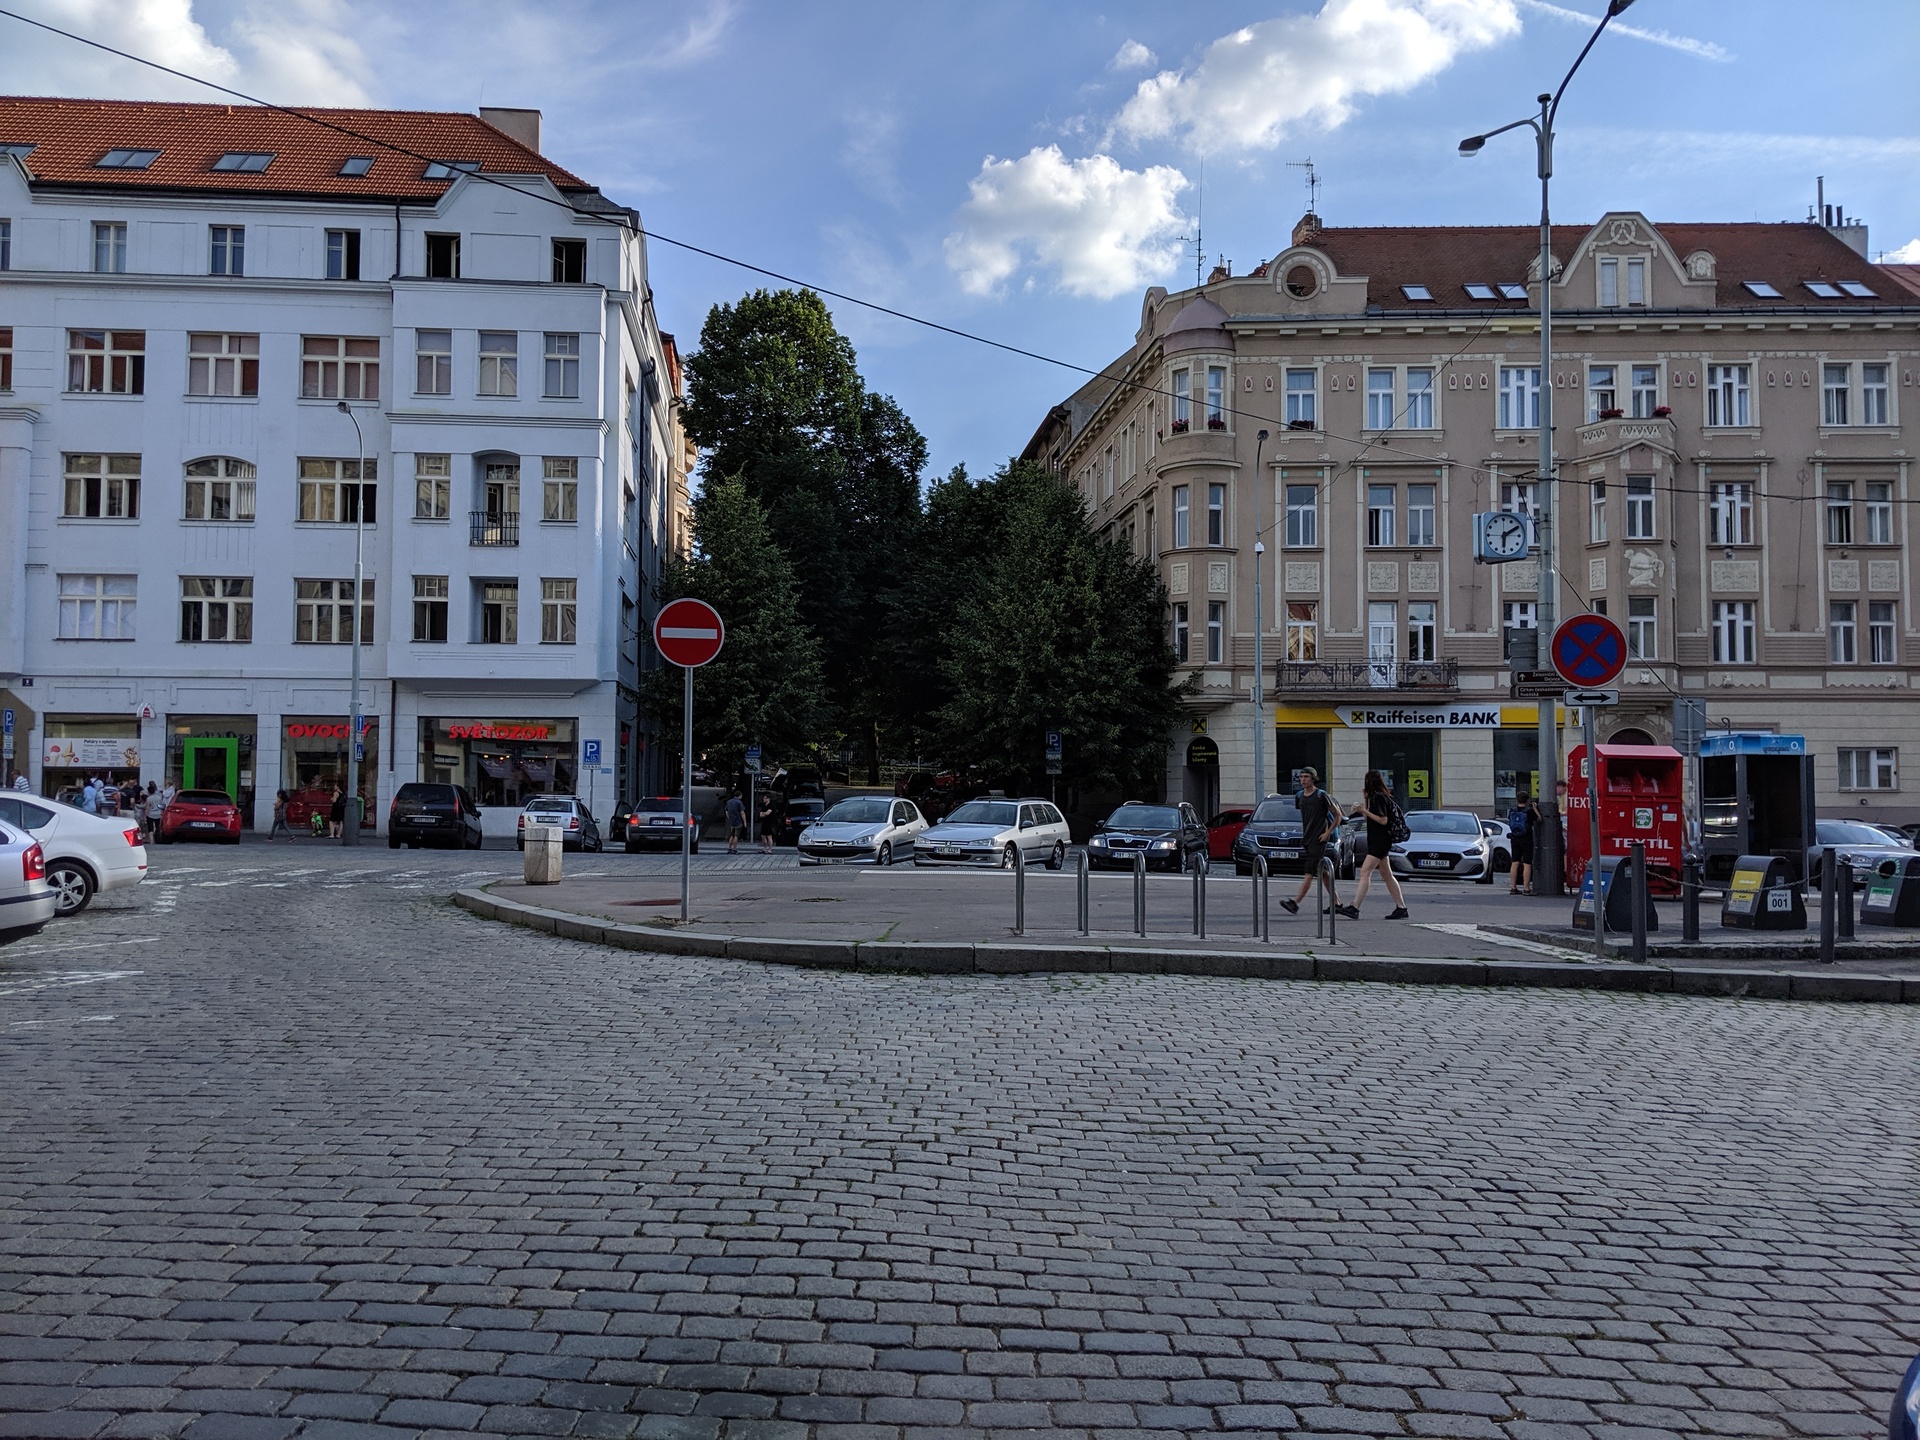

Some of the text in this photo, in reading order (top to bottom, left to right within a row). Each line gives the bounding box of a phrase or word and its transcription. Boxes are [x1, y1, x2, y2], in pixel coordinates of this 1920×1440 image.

[1366, 710, 1498, 725] Raiffeisen BANK
[448, 722, 548, 740] SVĚTOZOR
[587, 742, 598, 756] P
[1413, 779, 1424, 794] 3
[1772, 898, 1788, 908] 001
